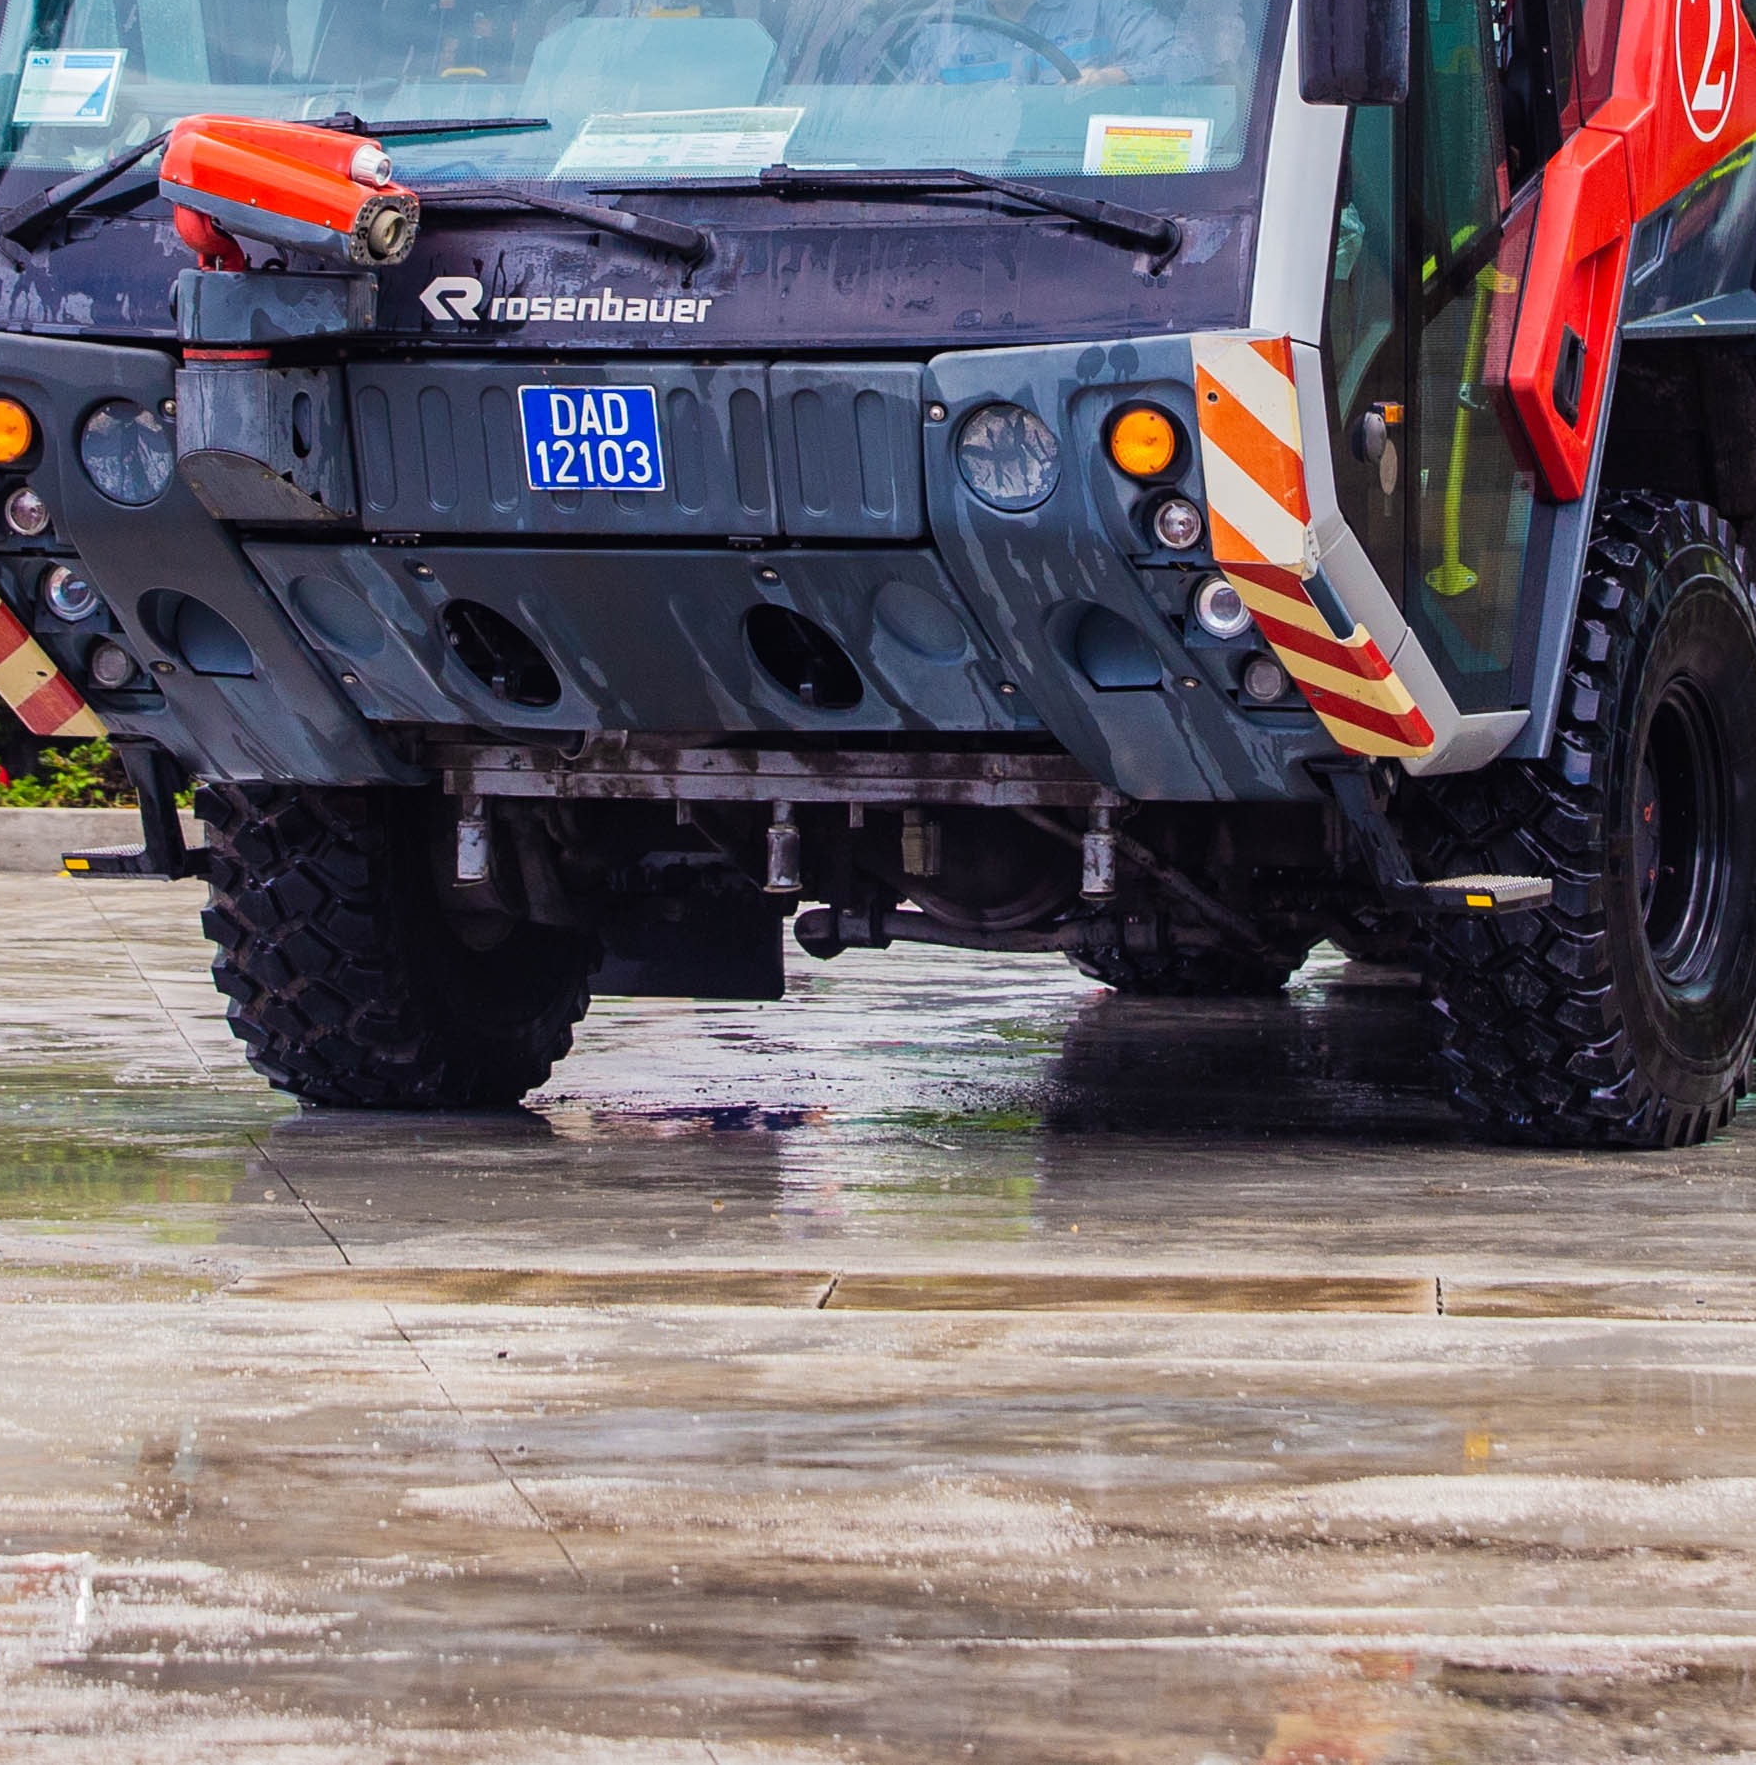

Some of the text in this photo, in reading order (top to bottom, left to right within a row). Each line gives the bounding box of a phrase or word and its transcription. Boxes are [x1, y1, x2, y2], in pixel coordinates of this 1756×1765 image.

[490, 286, 713, 324] rosenbauer
[549, 392, 630, 437] DAD
[536, 439, 653, 484] 12103
